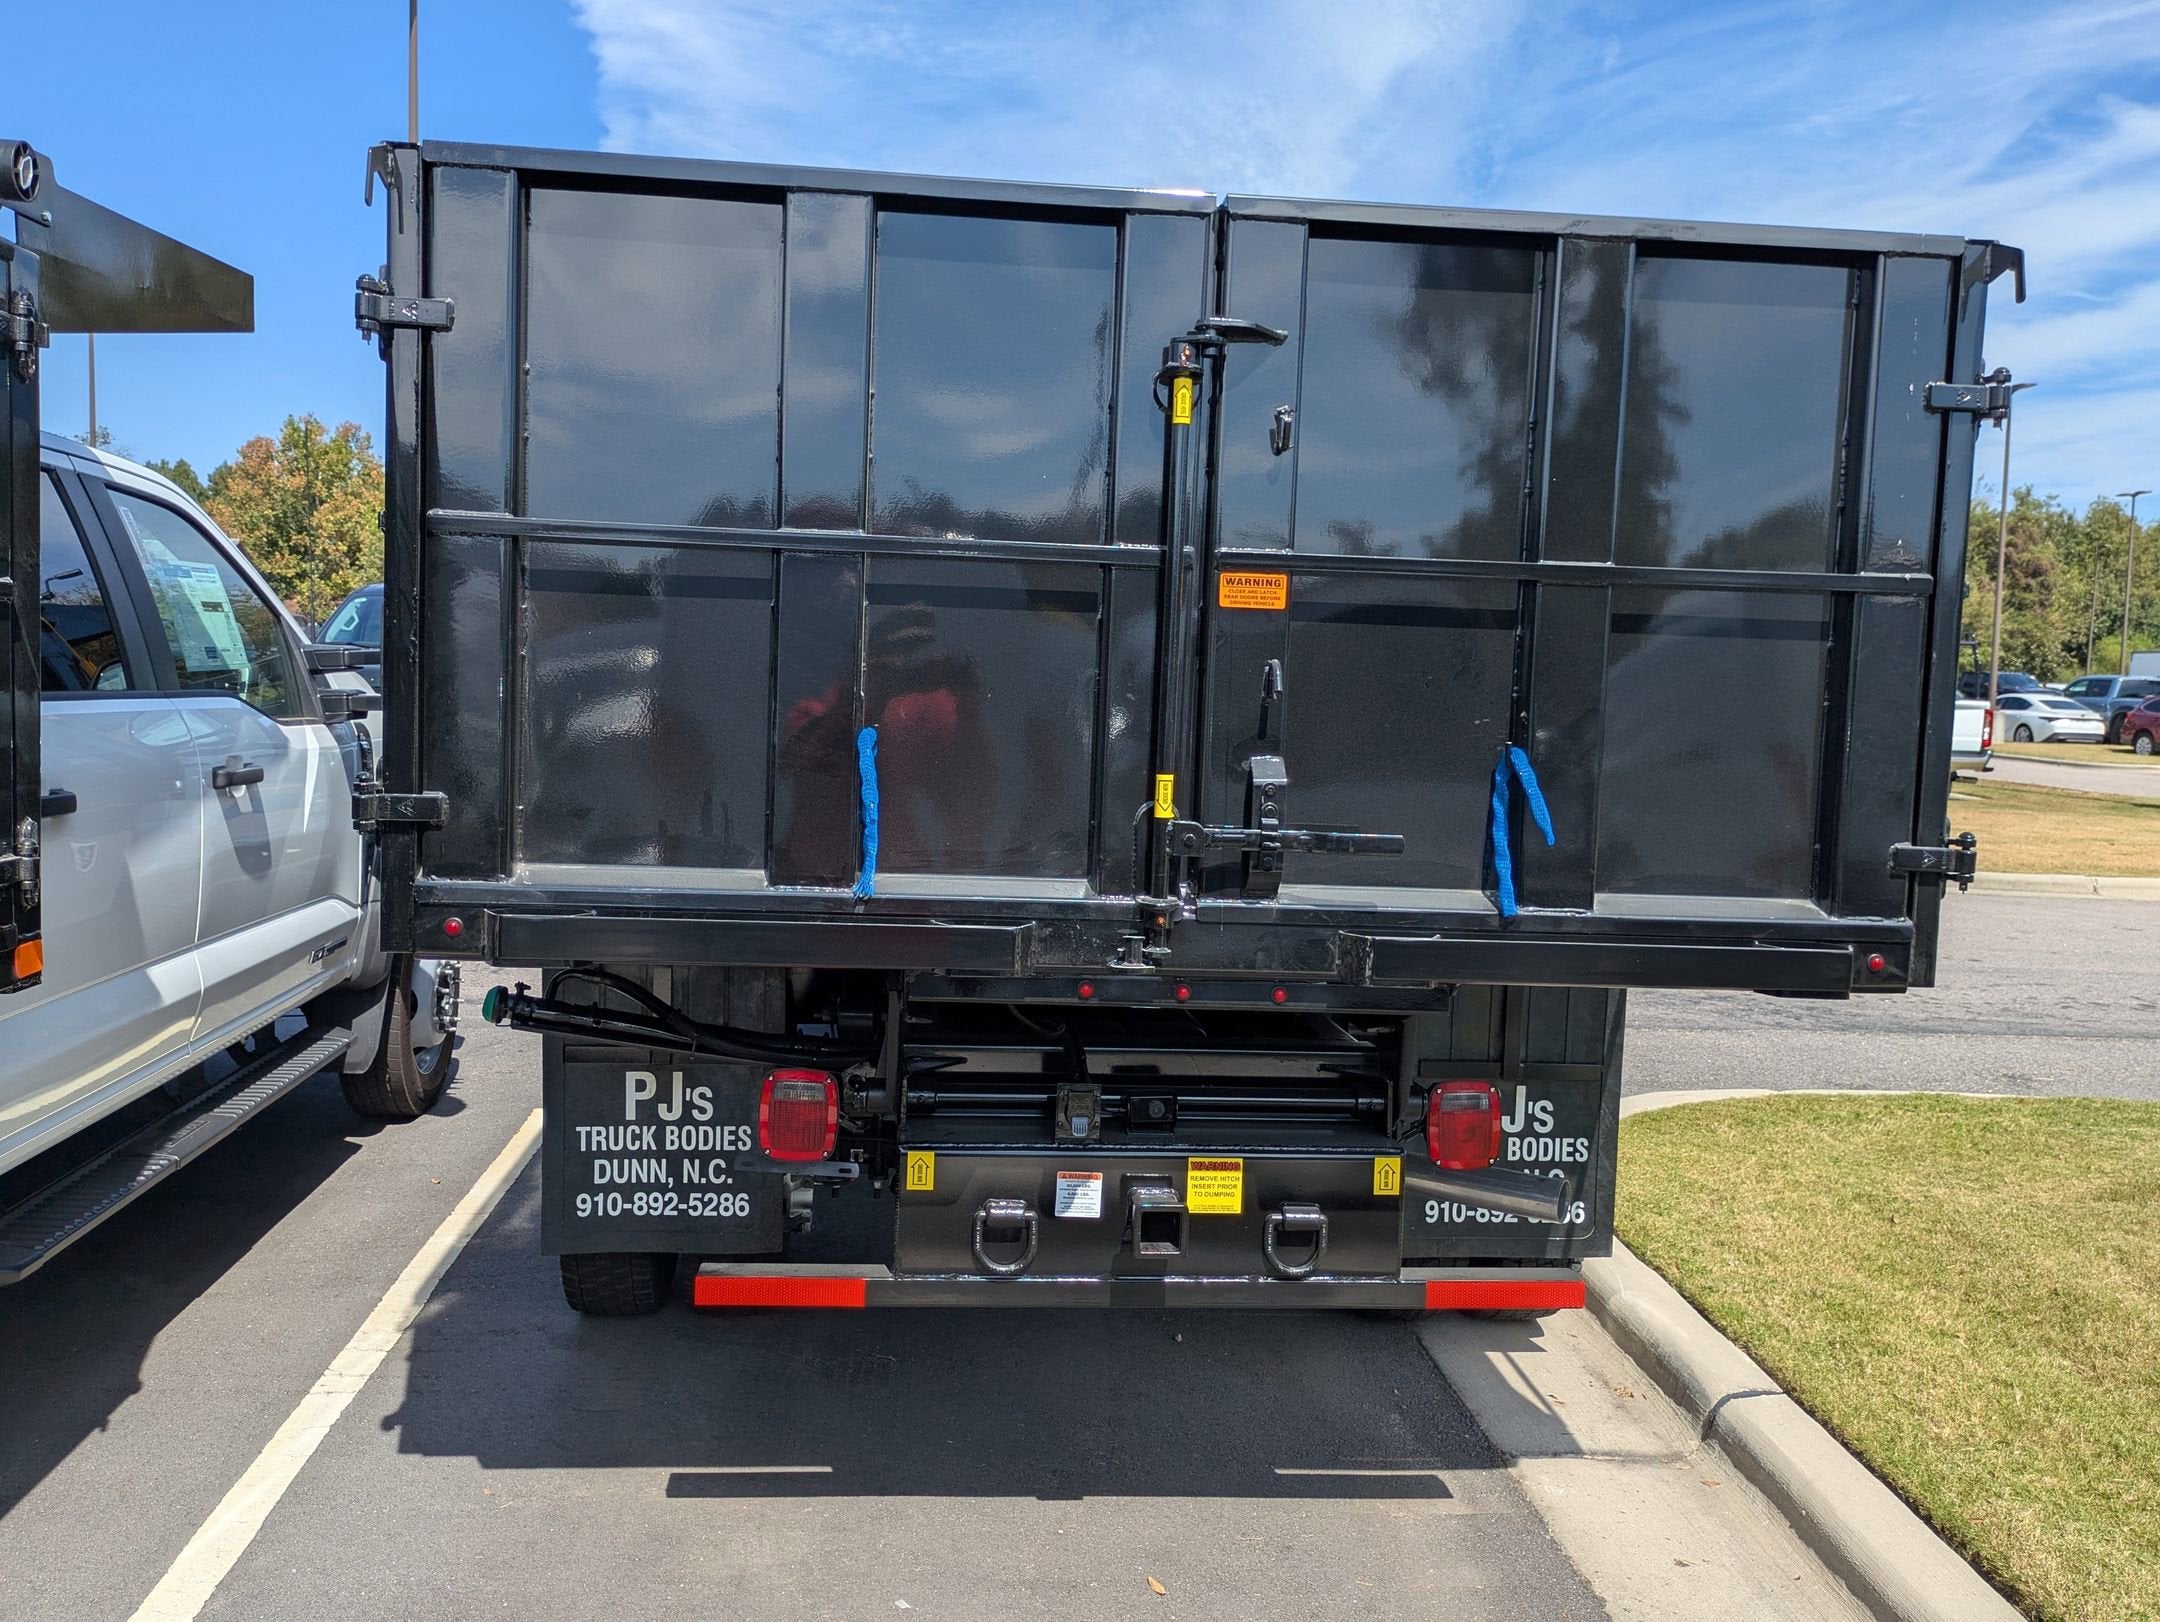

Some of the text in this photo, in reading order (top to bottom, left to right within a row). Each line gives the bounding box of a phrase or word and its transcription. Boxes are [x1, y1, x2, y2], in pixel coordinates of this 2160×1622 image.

[1225, 577, 1281, 587] WARNING
[576, 1125, 752, 1152] TRUCK BODIES
[1507, 1136, 1589, 1162] BODIES
[594, 1158, 733, 1188] DUNN, N.C.
[1190, 1161, 1241, 1171] WARNING
[576, 1192, 750, 1218] 910-892-5286
